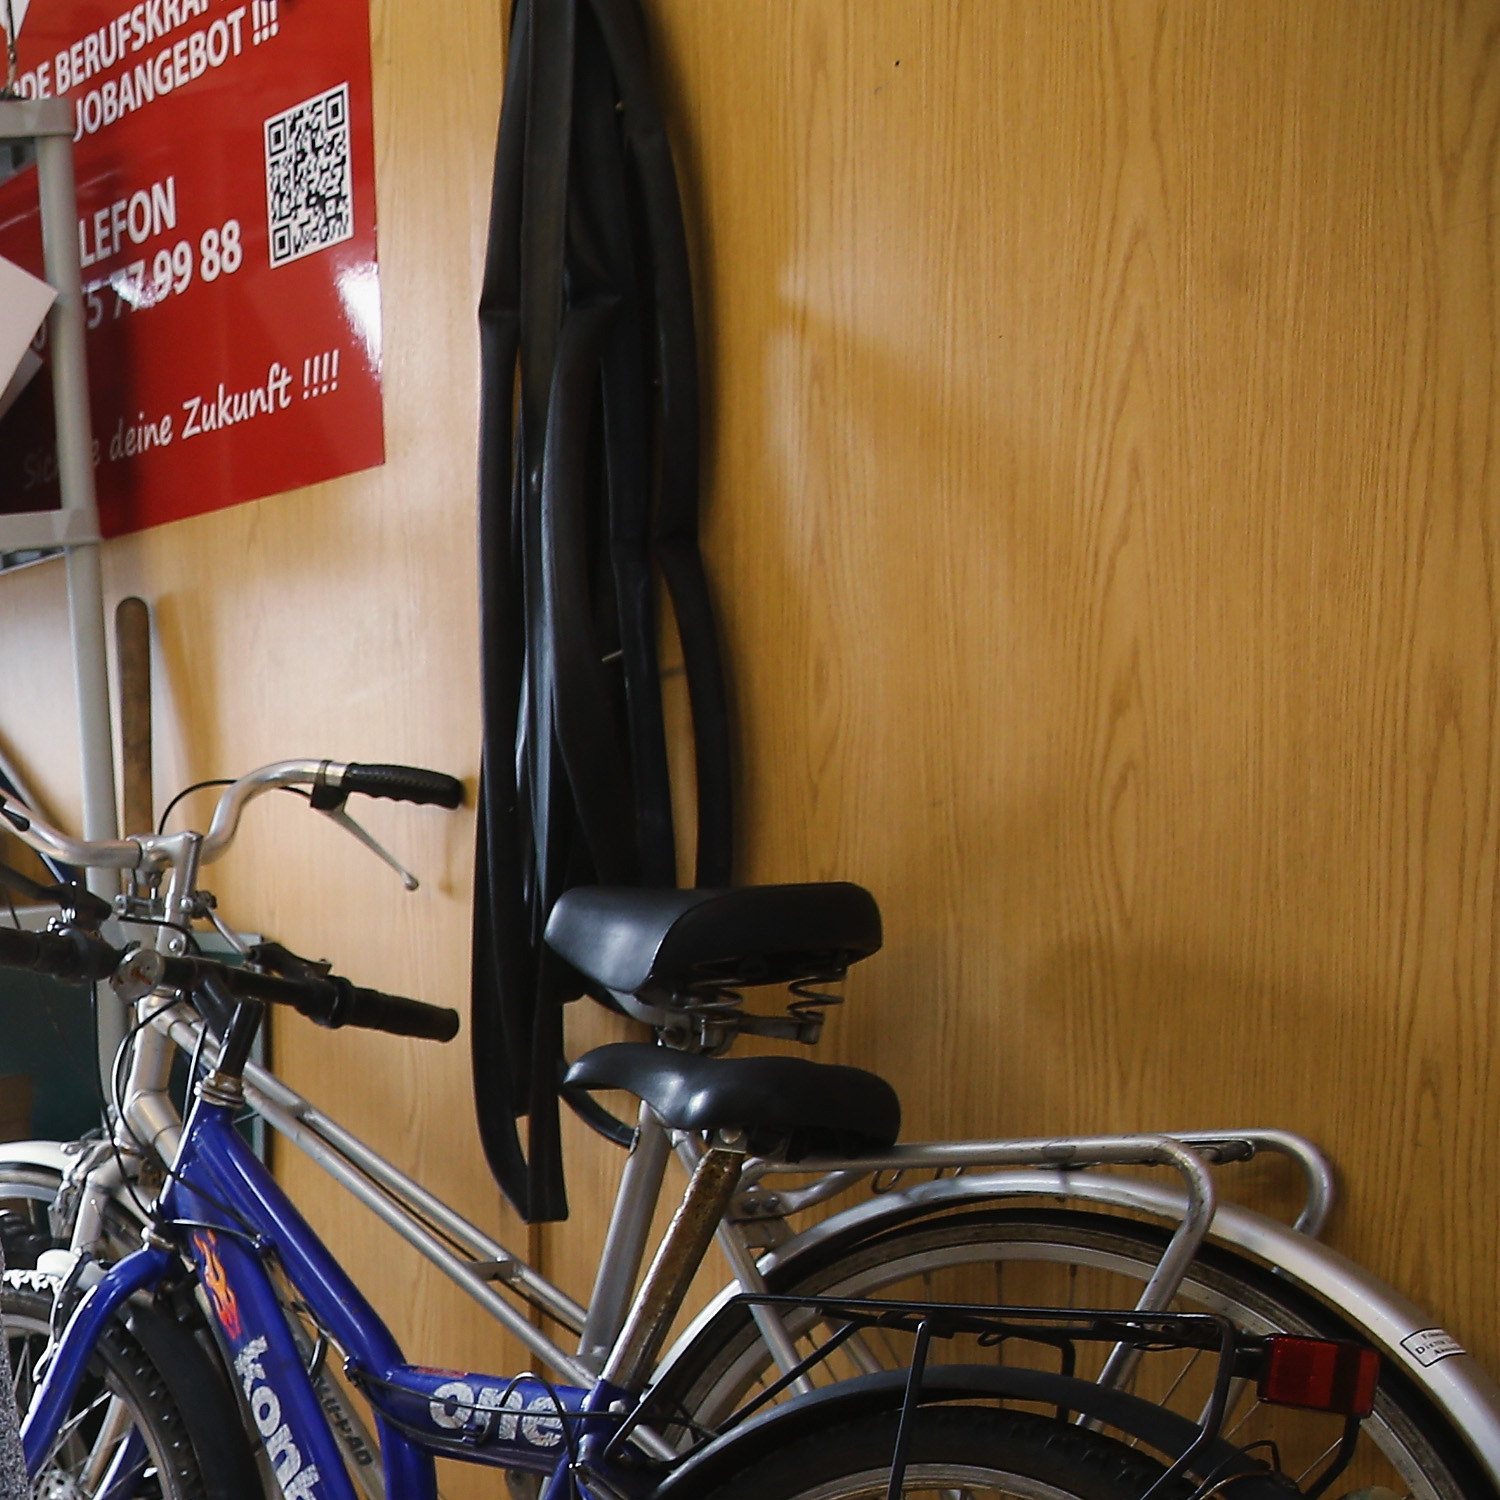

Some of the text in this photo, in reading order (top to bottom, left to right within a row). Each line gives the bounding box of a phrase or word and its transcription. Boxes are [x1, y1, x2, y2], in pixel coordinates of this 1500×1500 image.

[73, 6, 246, 142] JOBANGEBOT
[78, 176, 176, 268] LEFON
[200, 219, 242, 283] 88
[109, 410, 173, 462] deine
[181, 361, 293, 440] Zukunft
[429, 1381, 568, 1447] one
